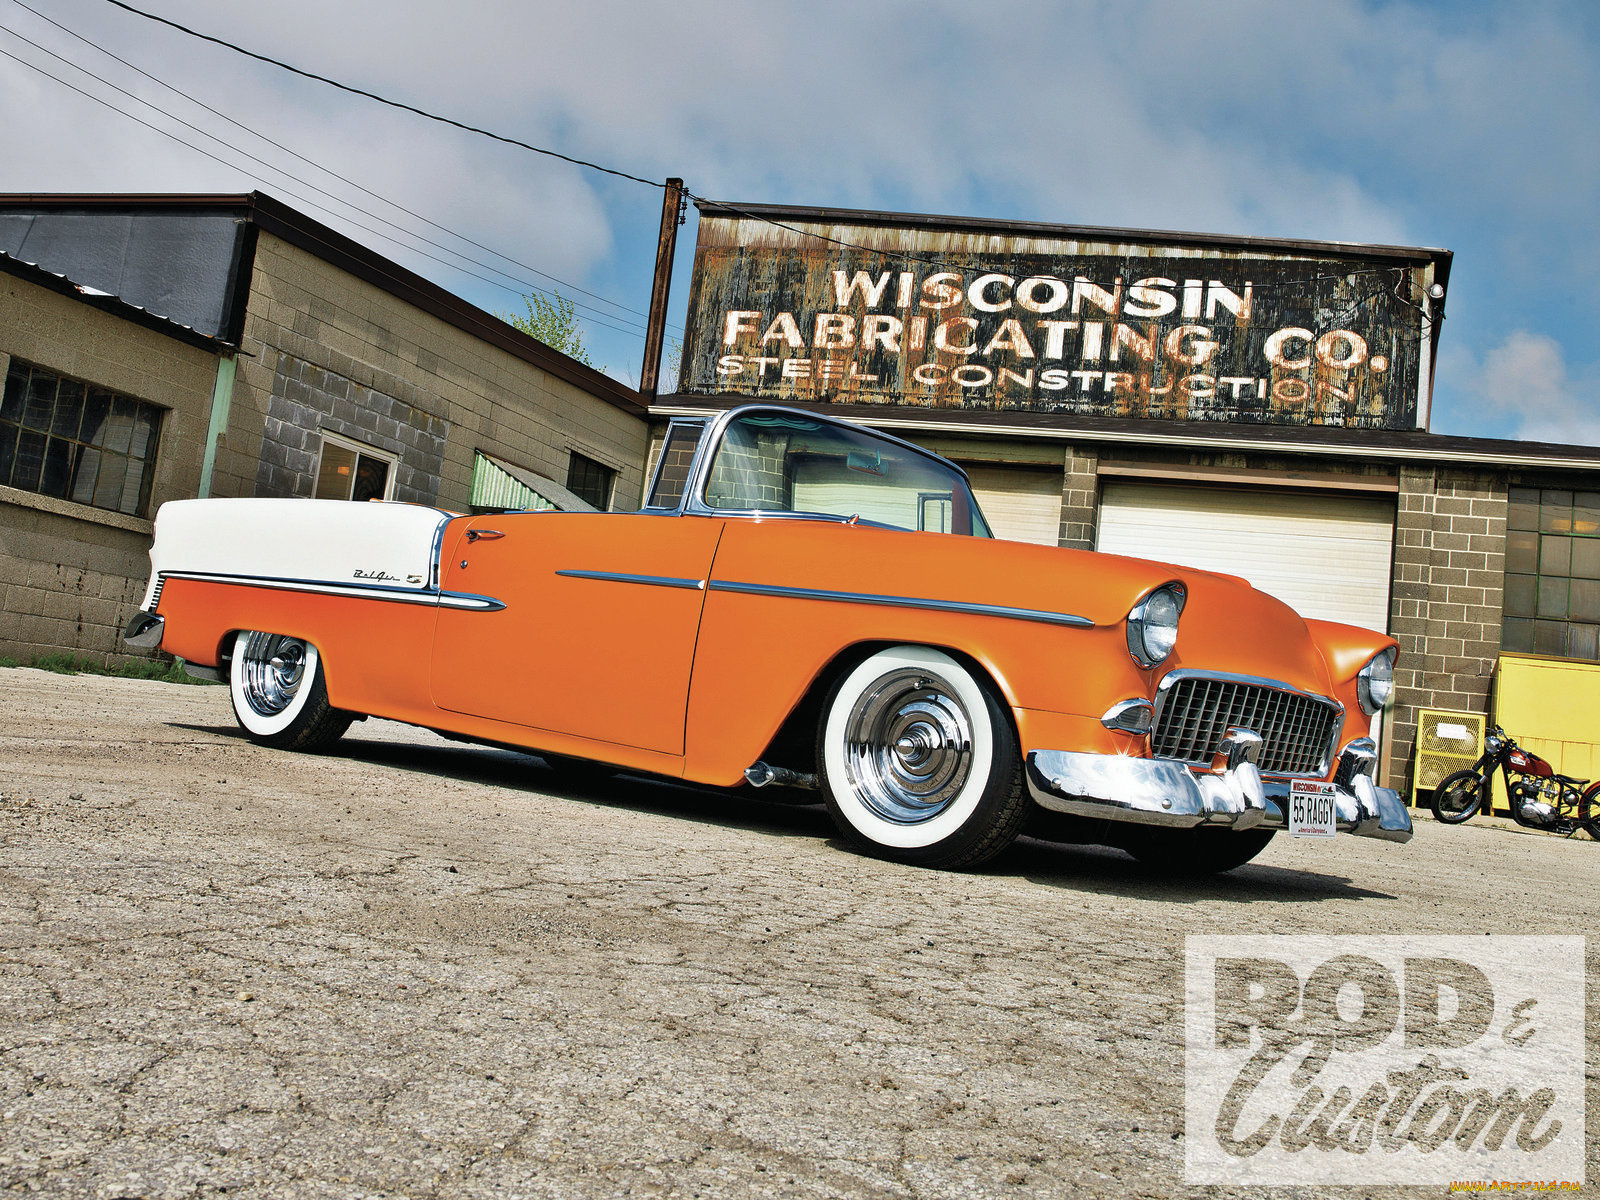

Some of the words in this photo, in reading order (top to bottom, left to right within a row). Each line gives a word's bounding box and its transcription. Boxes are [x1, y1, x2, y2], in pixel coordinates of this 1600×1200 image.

[833, 270, 1252, 319] WISCONSIN
[723, 310, 1219, 365] FABRICATING
[1263, 327, 1388, 373] CO.
[716, 355, 879, 380] STEEL
[912, 363, 1355, 402] CONSTRUCTION
[1294, 796, 1304, 823] 55
[1307, 797, 1333, 825] RAGGY
